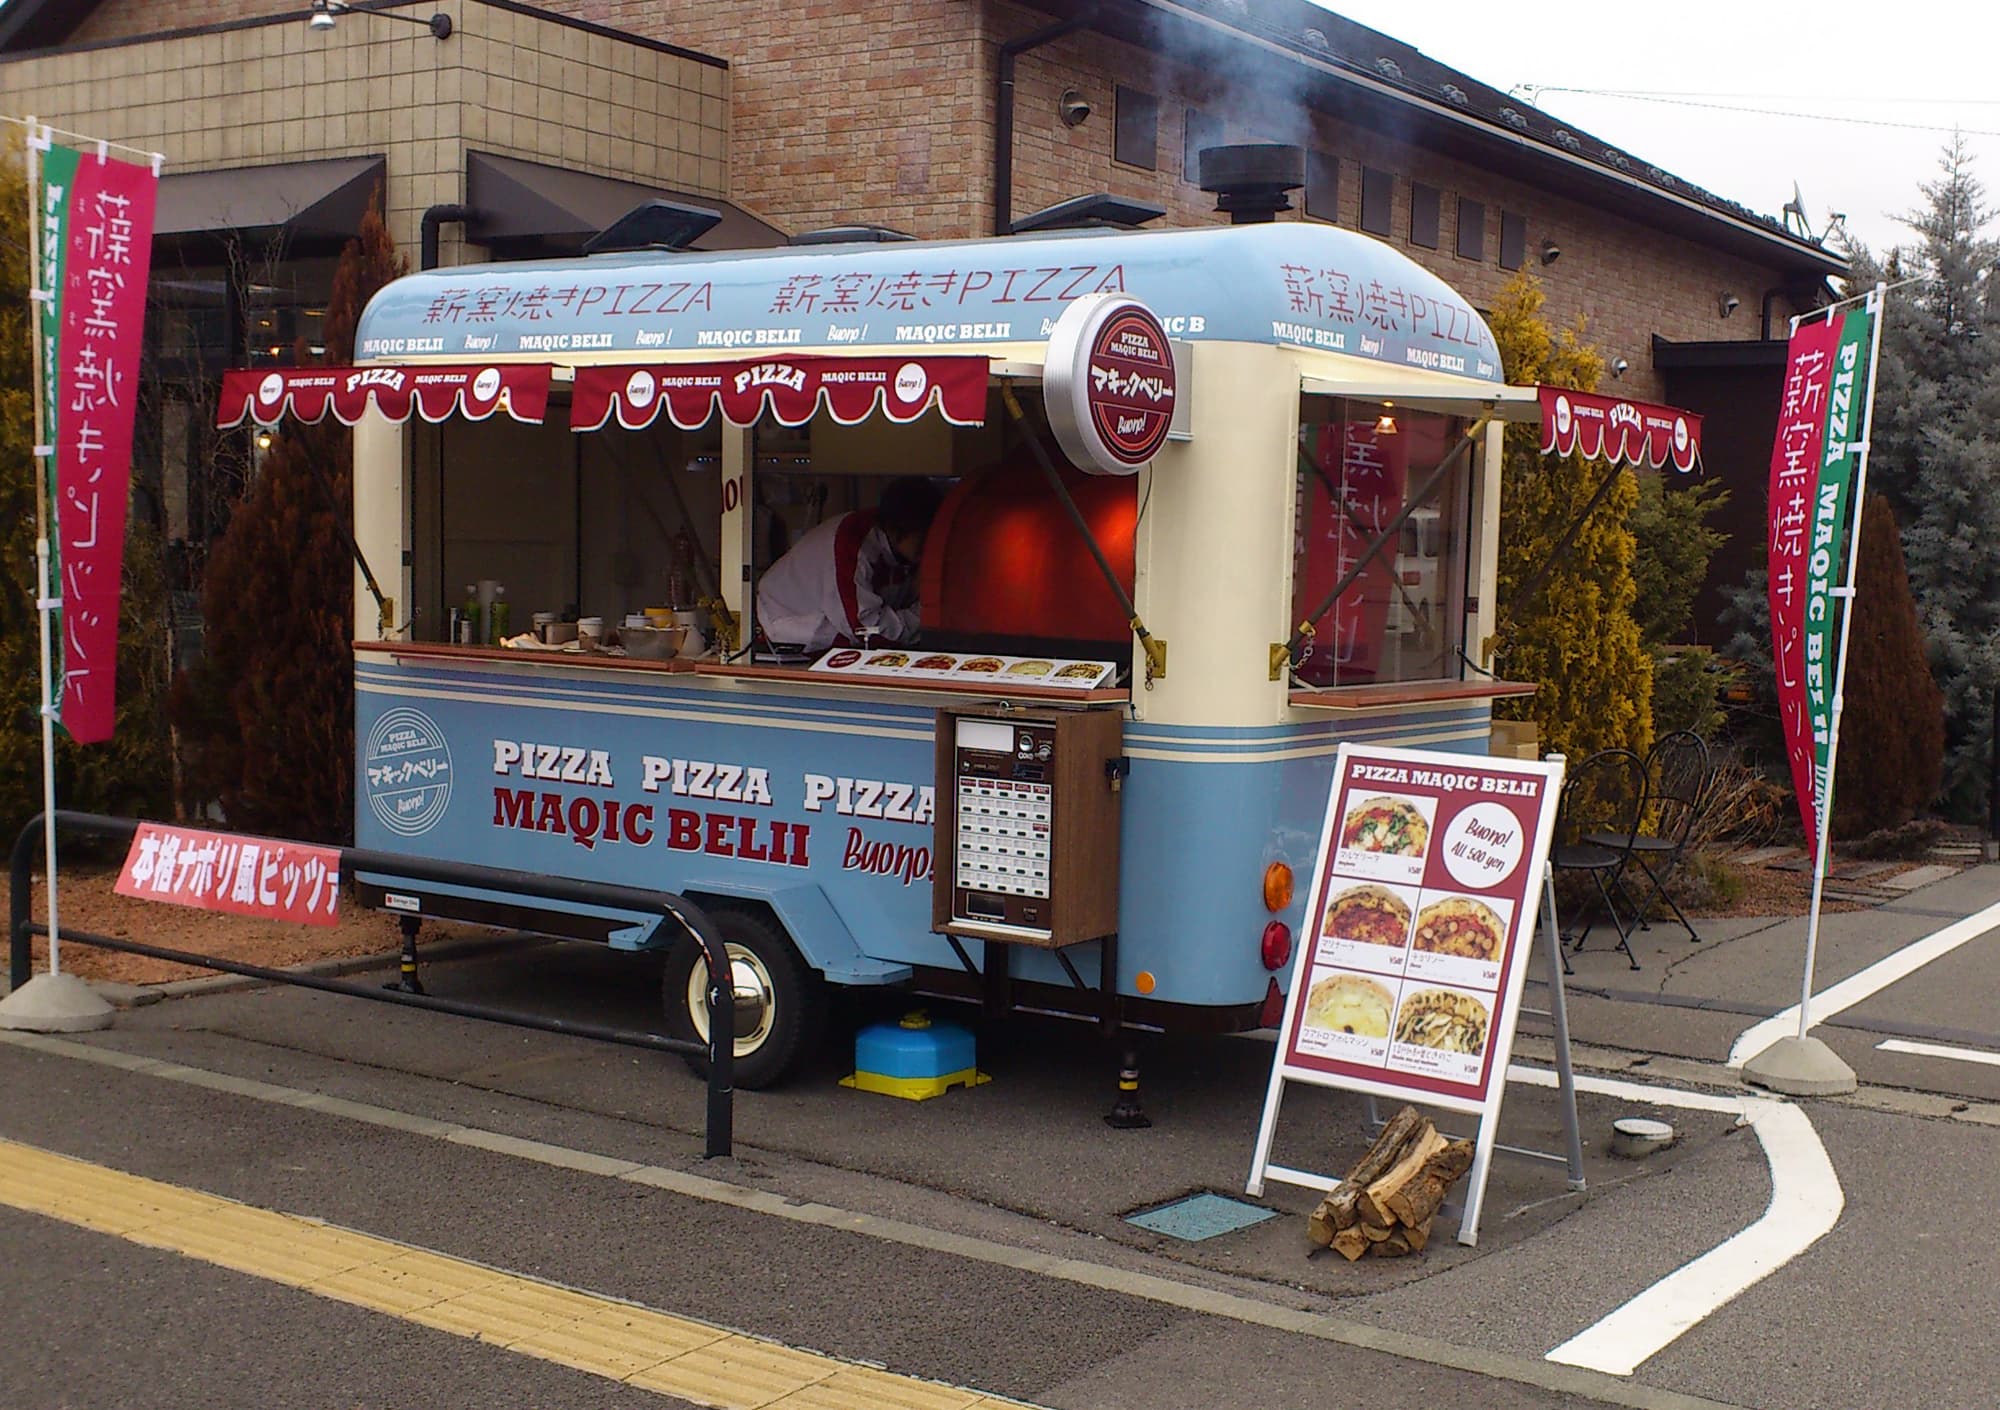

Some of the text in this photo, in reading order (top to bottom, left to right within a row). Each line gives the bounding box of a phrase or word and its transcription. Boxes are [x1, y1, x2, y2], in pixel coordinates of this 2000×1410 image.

[895, 325, 957, 342] MAQIC
[1121, 332, 1149, 347] PIZZA
[346, 368, 405, 392] PIZZA
[733, 363, 807, 394] PIZZA
[1609, 402, 1642, 432] PIZZA
[1826, 341, 1859, 466] PIZZA
[1772, 349, 1824, 805] 薪窯焼きピッツ
[493, 738, 935, 825] PIZZA PIZZA PIZZA
[1351, 764, 1538, 797] PIZZA MAQIC BELII
[492, 787, 656, 851] MAQIC
[667, 808, 812, 868] BELII
[1465, 818, 1513, 848] Buono!
[1466, 849, 1484, 864] 500
[1484, 855, 1505, 873] yen
